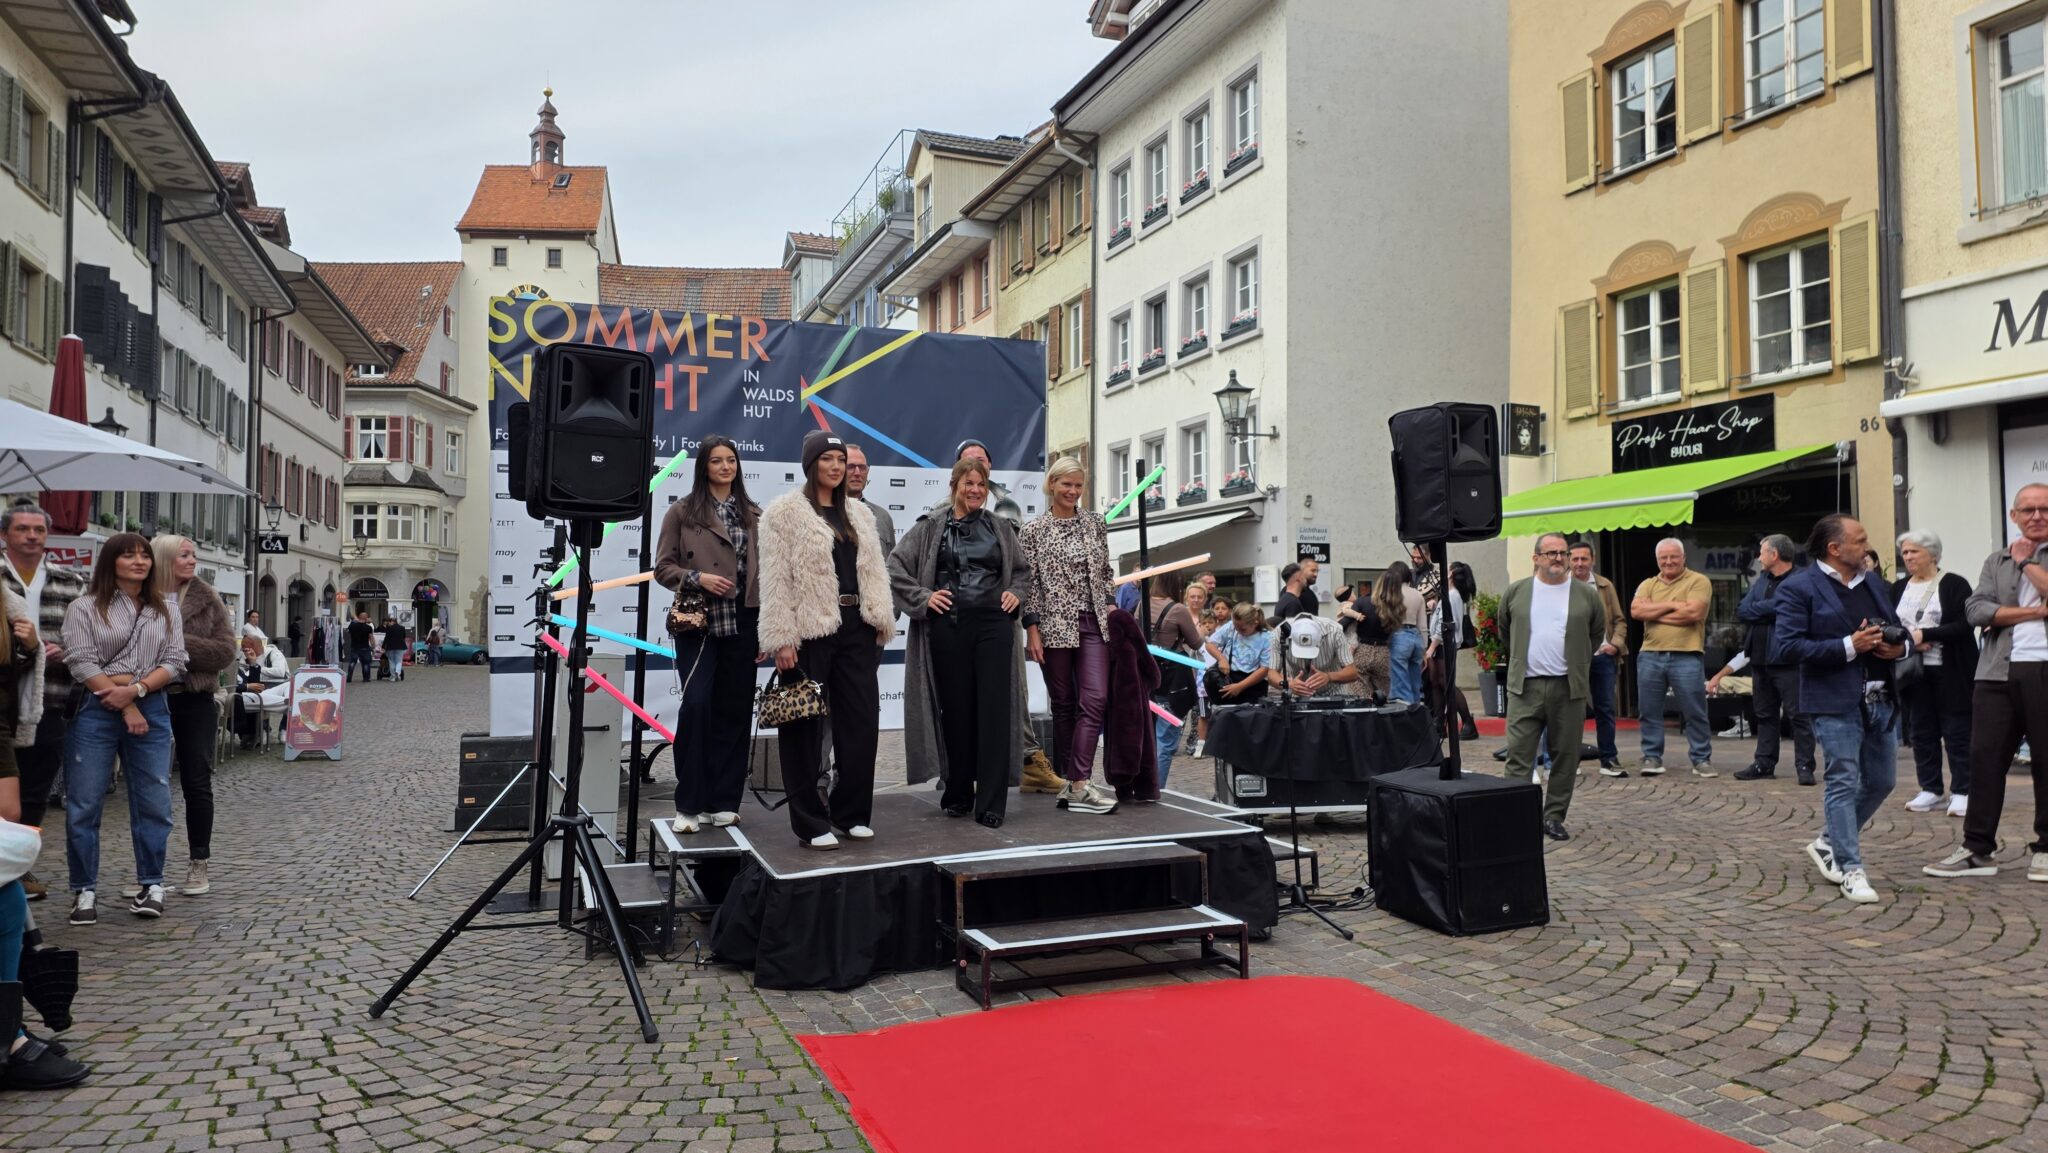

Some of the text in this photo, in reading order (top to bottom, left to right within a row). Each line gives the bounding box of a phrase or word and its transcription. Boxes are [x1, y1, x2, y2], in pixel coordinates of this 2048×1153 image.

[488, 295, 770, 361] SOMMER
[488, 350, 708, 412] NHT
[743, 369, 760, 383] IN
[743, 387, 795, 402] WALDS
[743, 405, 773, 419] HUT
[1616, 405, 1764, 457] Profi Haar Shop
[1860, 416, 1880, 433] 86
[591, 455, 604, 463] RCF
[1022, 483, 1037, 491] may
[623, 524, 642, 532] may
[46, 548, 91, 562] ALE
[495, 549, 517, 558] may
[1300, 544, 1320, 554] 20m
